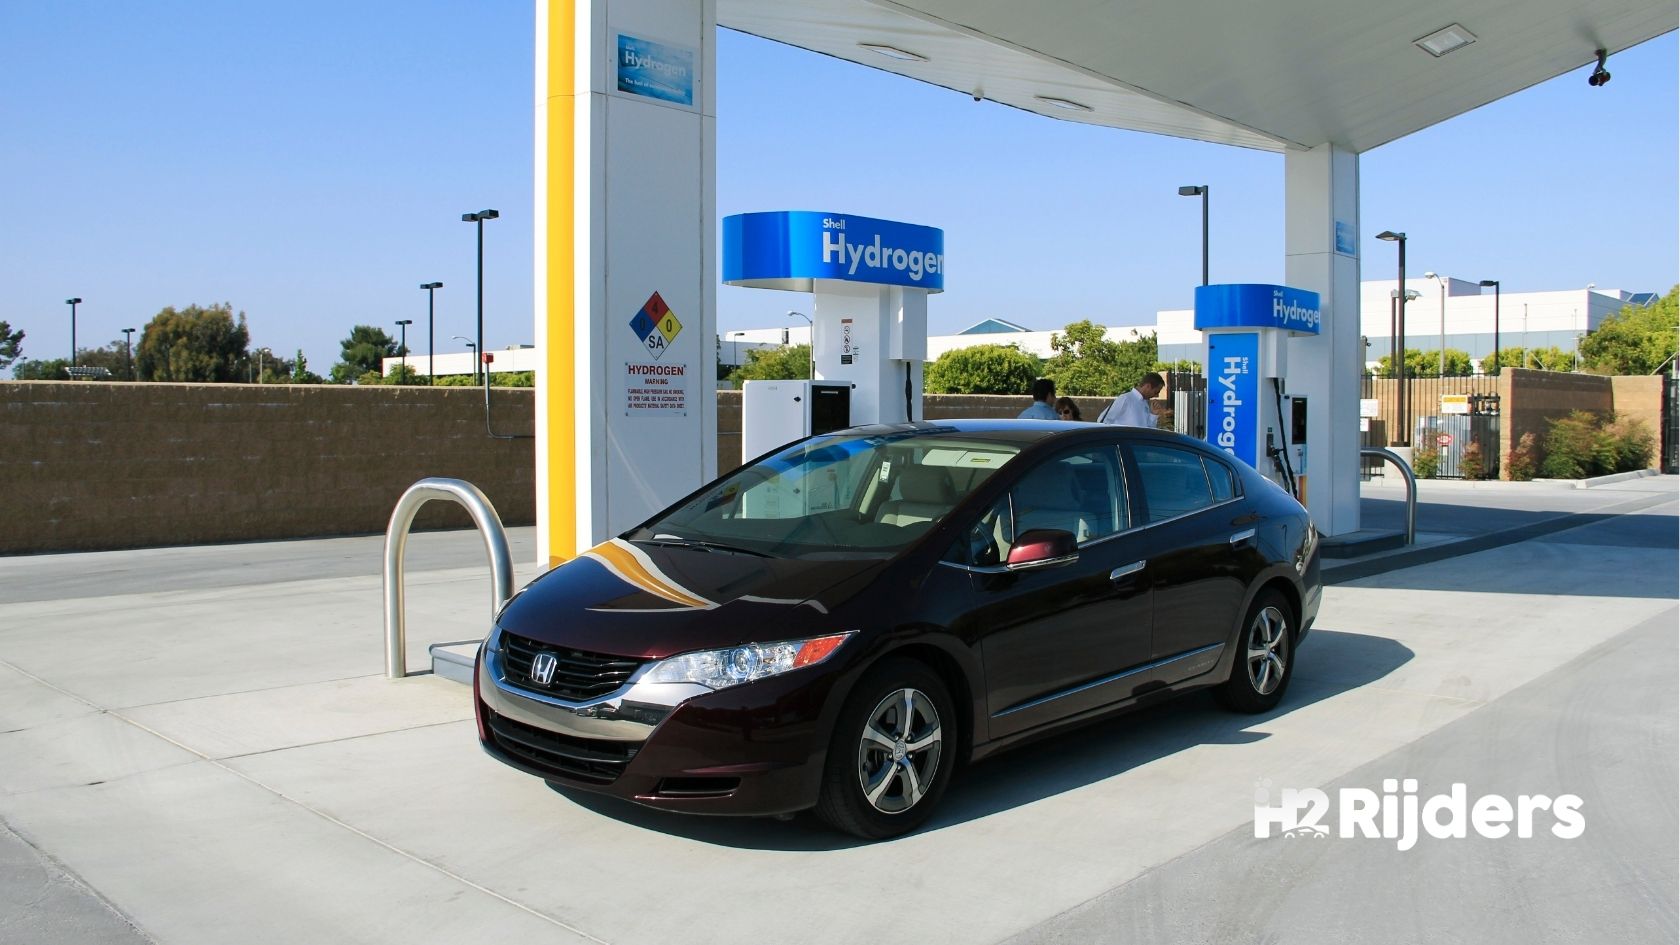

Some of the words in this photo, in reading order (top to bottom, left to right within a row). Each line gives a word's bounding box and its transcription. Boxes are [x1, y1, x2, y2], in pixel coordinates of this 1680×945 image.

[625, 50, 686, 77] Hydrogen
[823, 217, 846, 230] Shell
[1273, 298, 1320, 328] Hydroge
[666, 318, 673, 333] 0
[648, 335, 665, 349] SA
[628, 365, 684, 375] HYDROGEN
[1218, 356, 1242, 456] Hydrog
